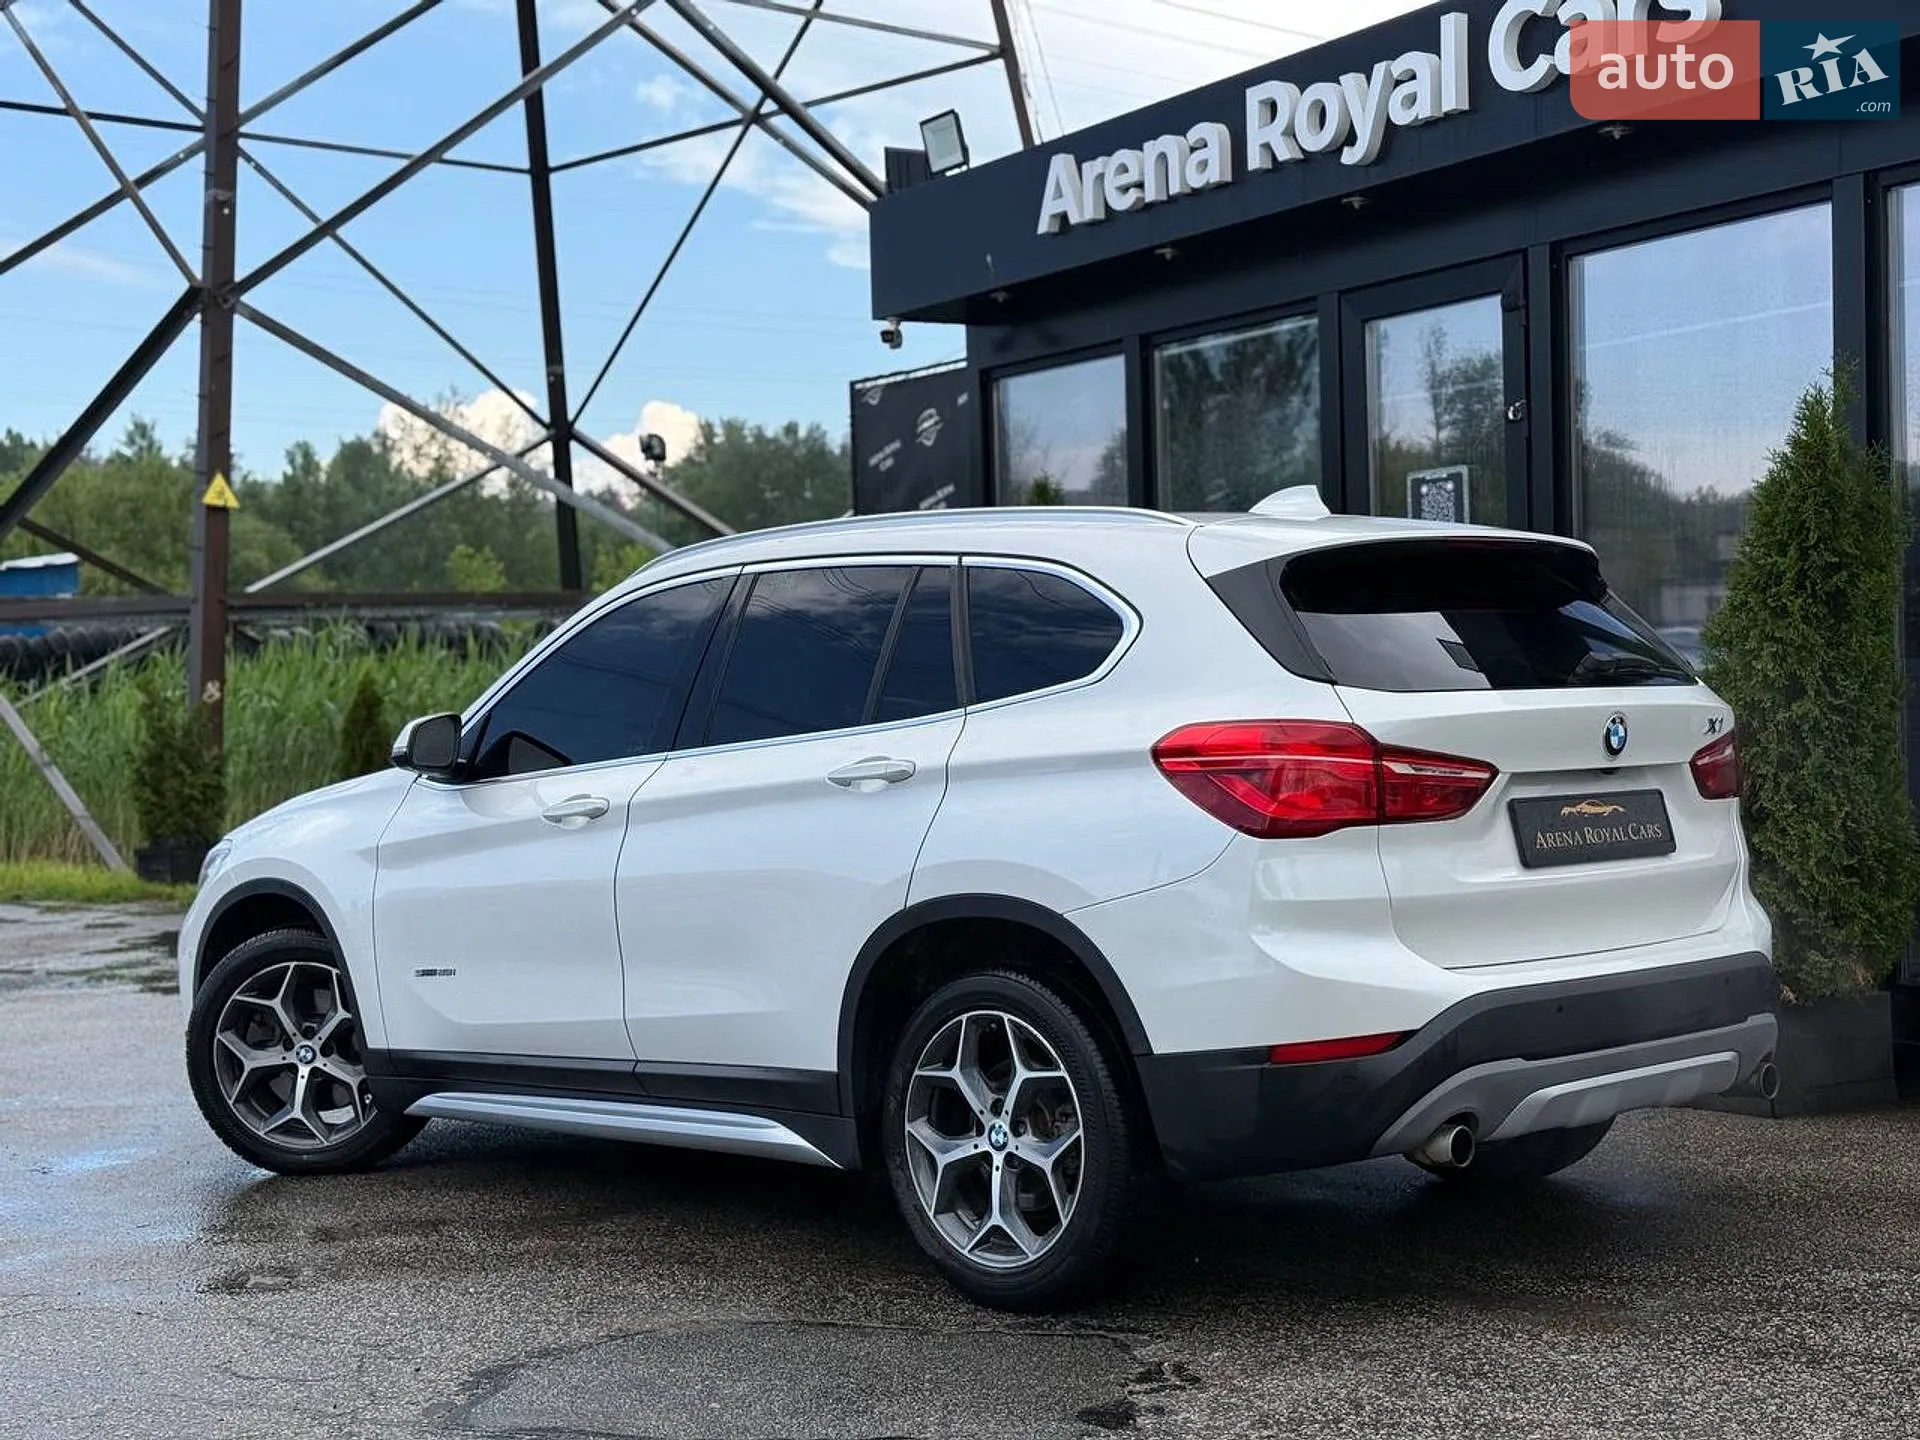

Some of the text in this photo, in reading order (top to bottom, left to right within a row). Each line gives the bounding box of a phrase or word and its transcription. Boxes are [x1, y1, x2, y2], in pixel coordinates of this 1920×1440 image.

[1037, 121, 1232, 235] Arena
[1245, 12, 1469, 172] Royal
[1704, 717, 1723, 734] X1
